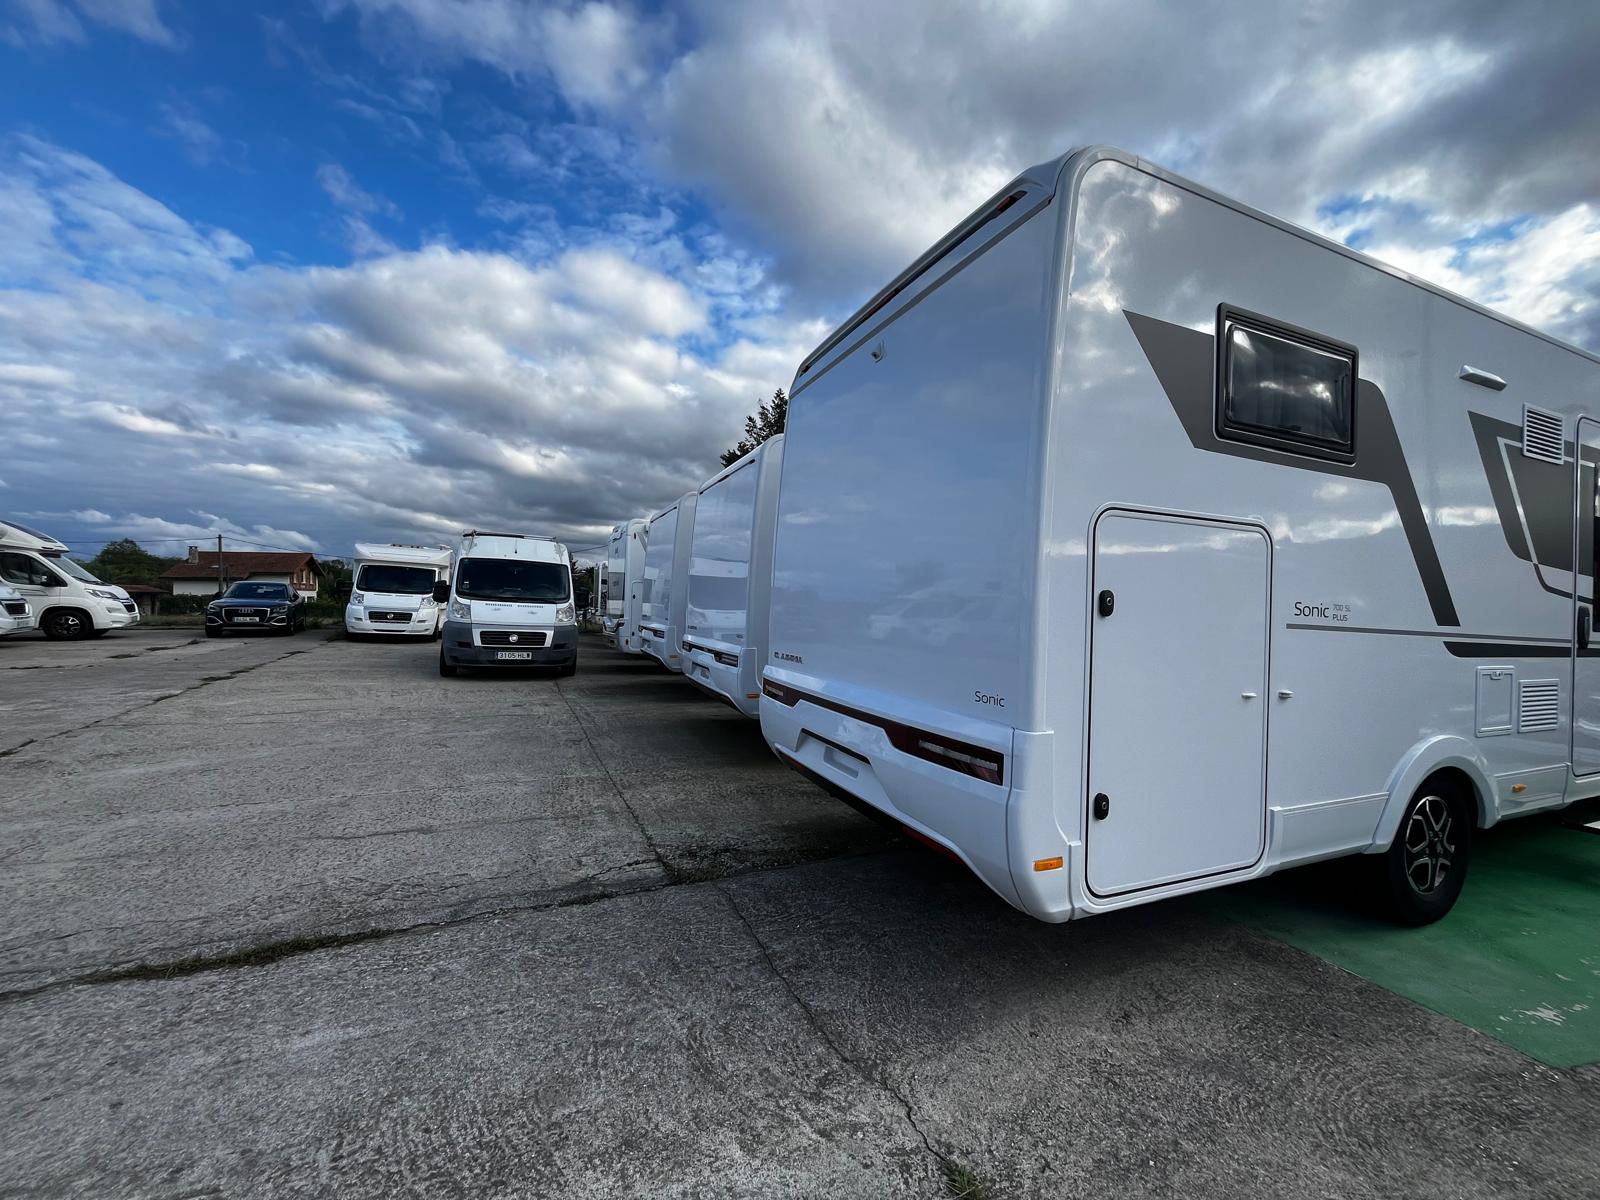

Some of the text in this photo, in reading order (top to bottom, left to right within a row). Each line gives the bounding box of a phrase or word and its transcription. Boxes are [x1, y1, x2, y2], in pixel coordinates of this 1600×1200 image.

[1294, 601, 1330, 618] Sonic
[1332, 613, 1348, 622] PLUS
[974, 690, 1005, 708] Sonic
